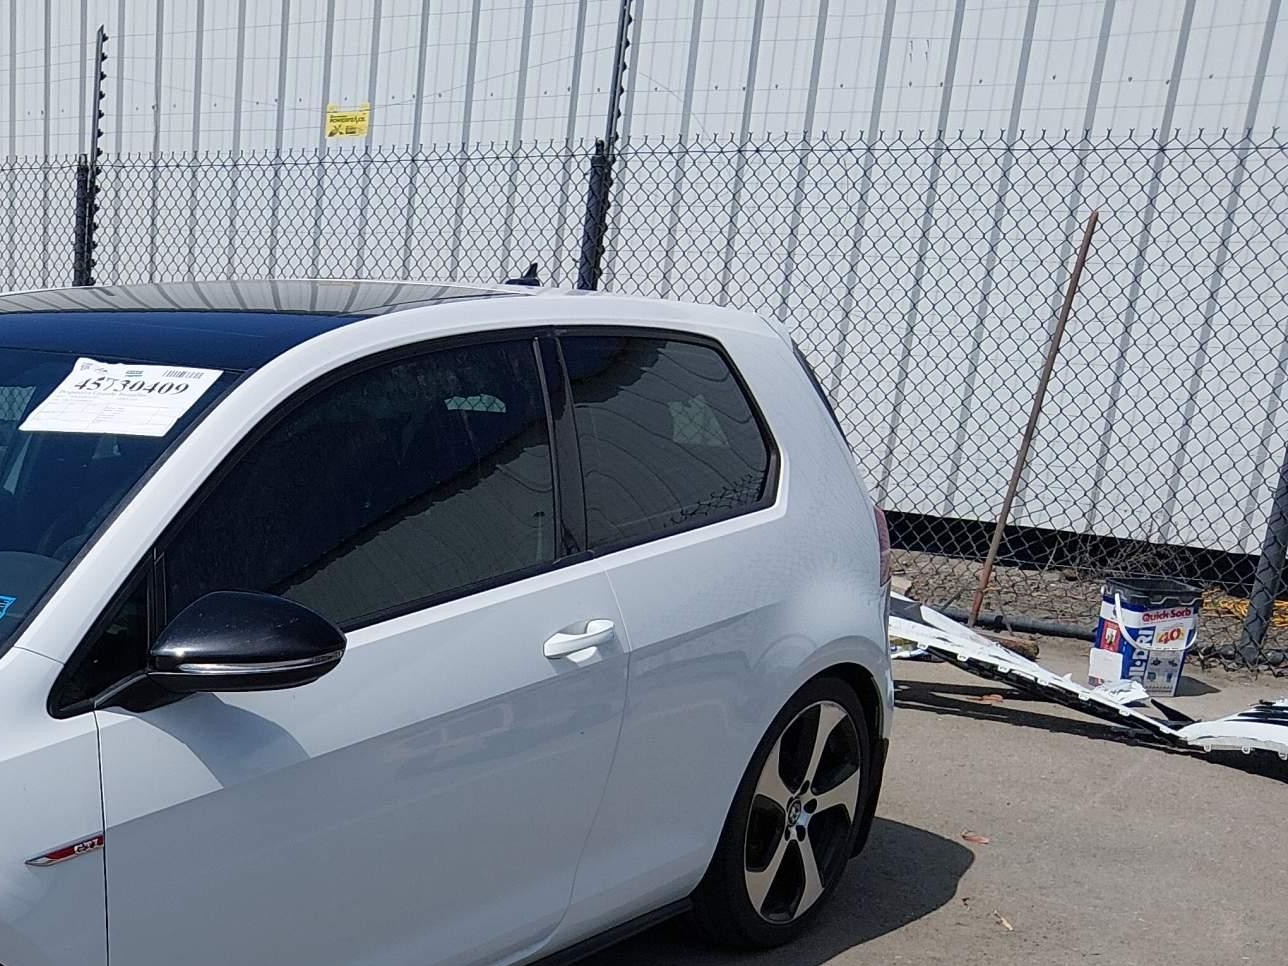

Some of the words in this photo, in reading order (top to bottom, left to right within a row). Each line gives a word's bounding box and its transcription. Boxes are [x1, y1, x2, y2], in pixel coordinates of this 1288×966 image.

[74, 376, 190, 396] 45730409
[1142, 610, 1169, 622] Quick
[1170, 607, 1192, 618] Sorb
[1158, 627, 1182, 645] 40
